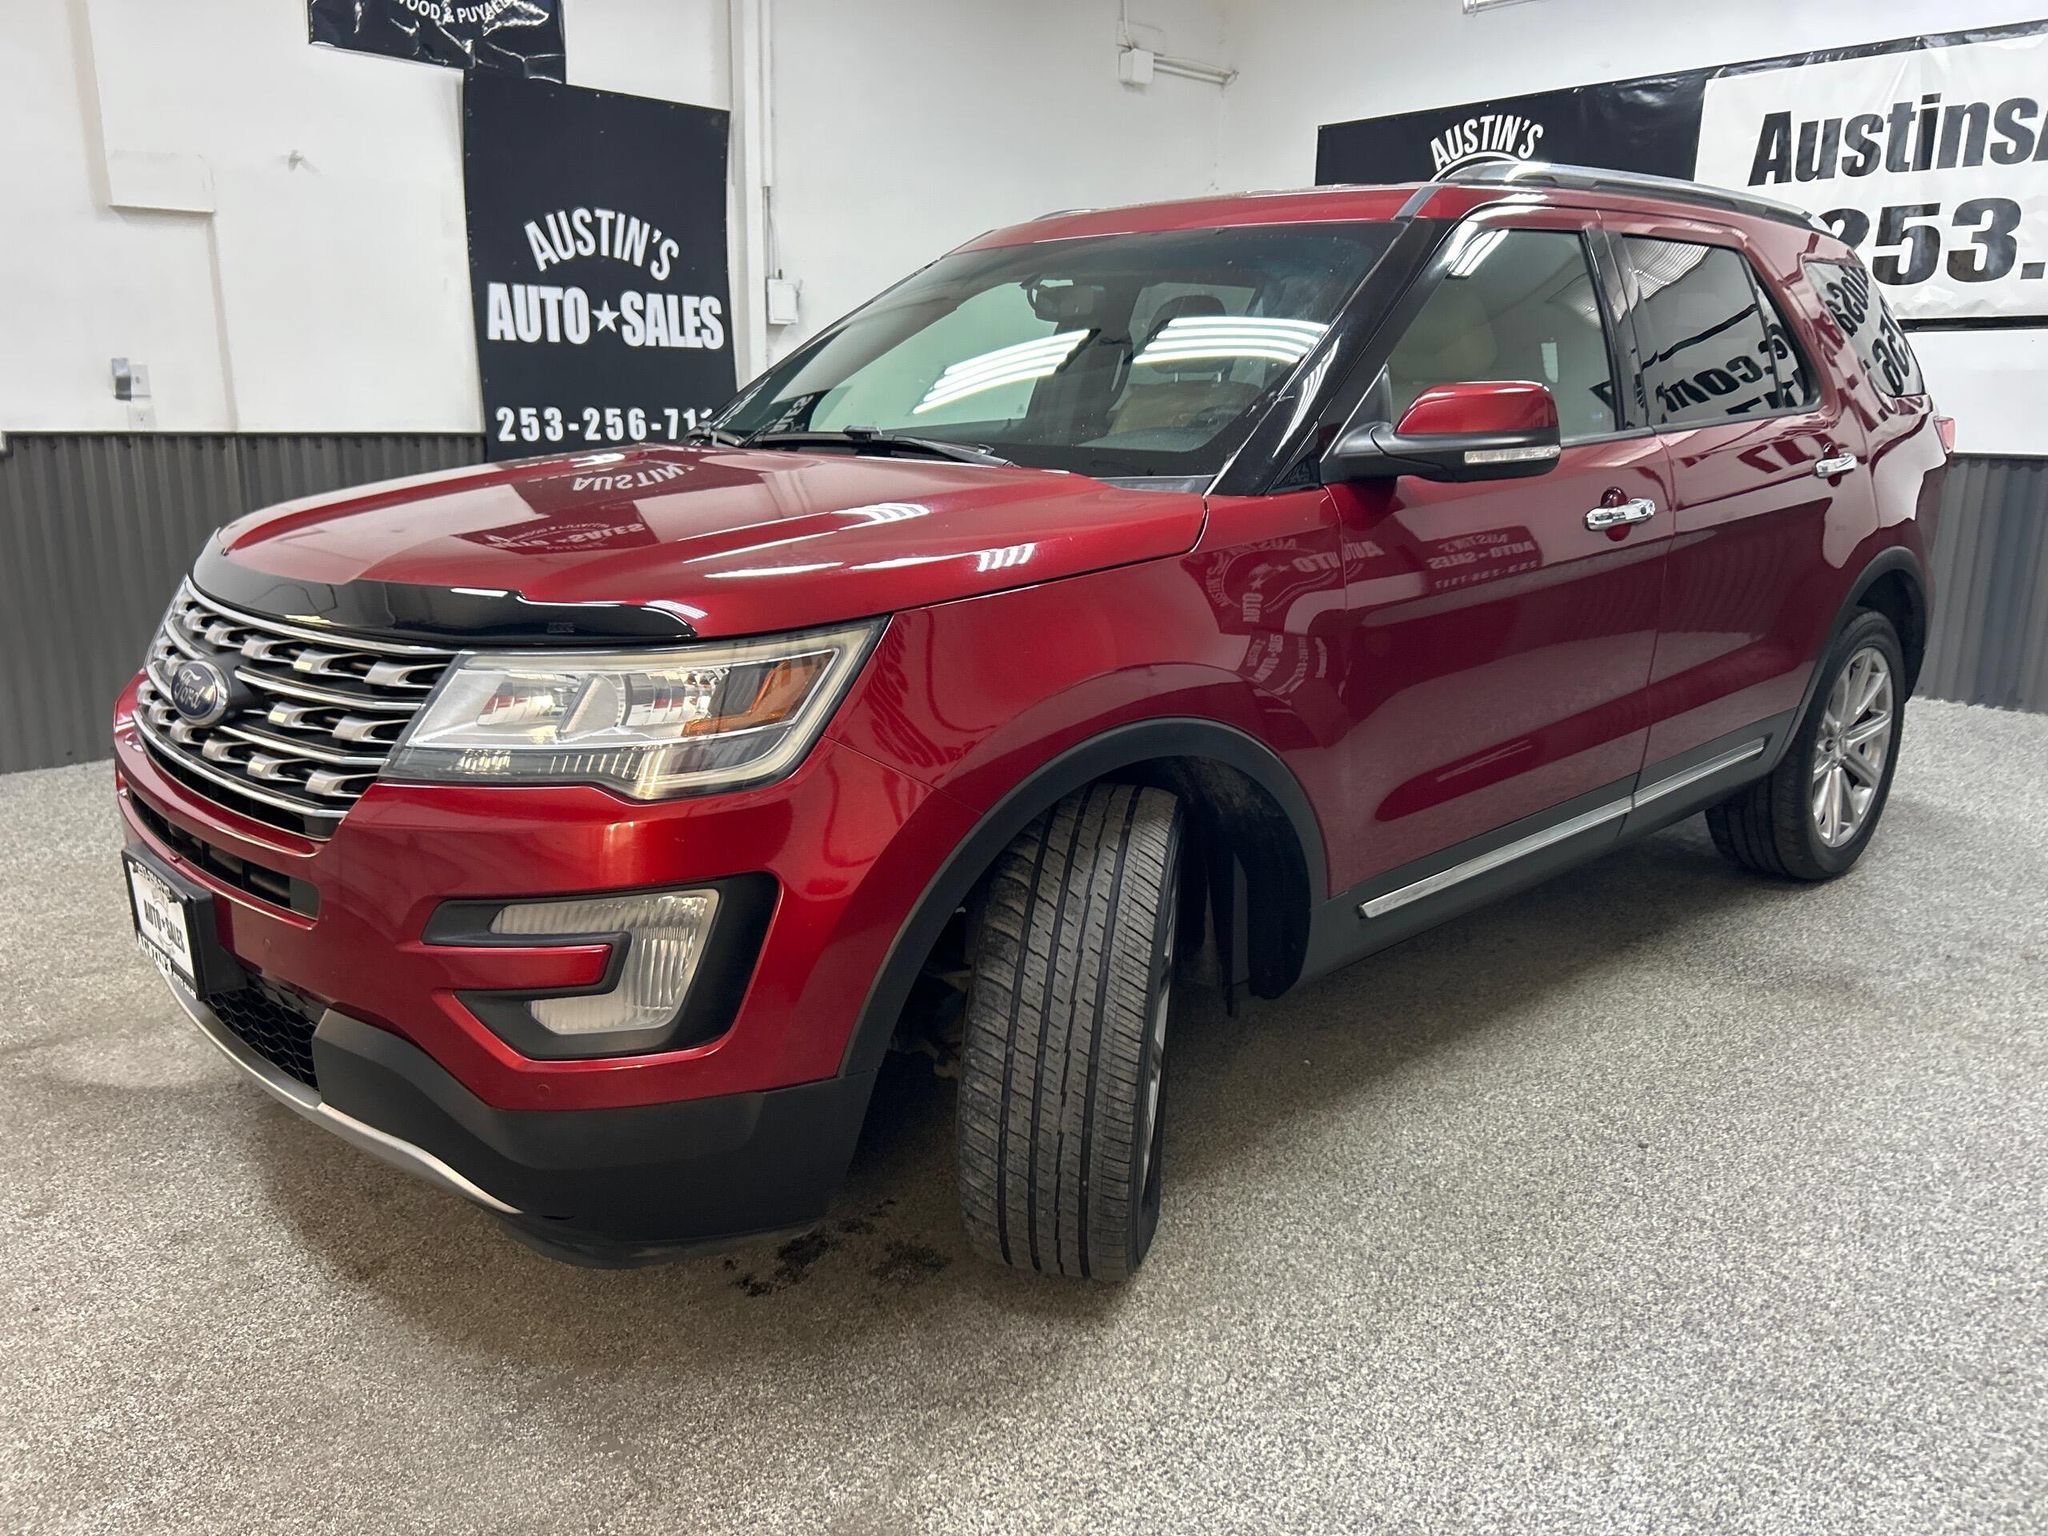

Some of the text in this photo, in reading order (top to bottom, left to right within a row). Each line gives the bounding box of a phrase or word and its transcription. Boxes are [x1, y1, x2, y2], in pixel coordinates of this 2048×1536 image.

[399, 0, 441, 20] OOD
[1430, 114, 1544, 171] AUSTIN'S
[524, 207, 680, 281] AUSTIN'S
[487, 282, 724, 350] AUTO SALES
[496, 406, 713, 442] 253-256-71
